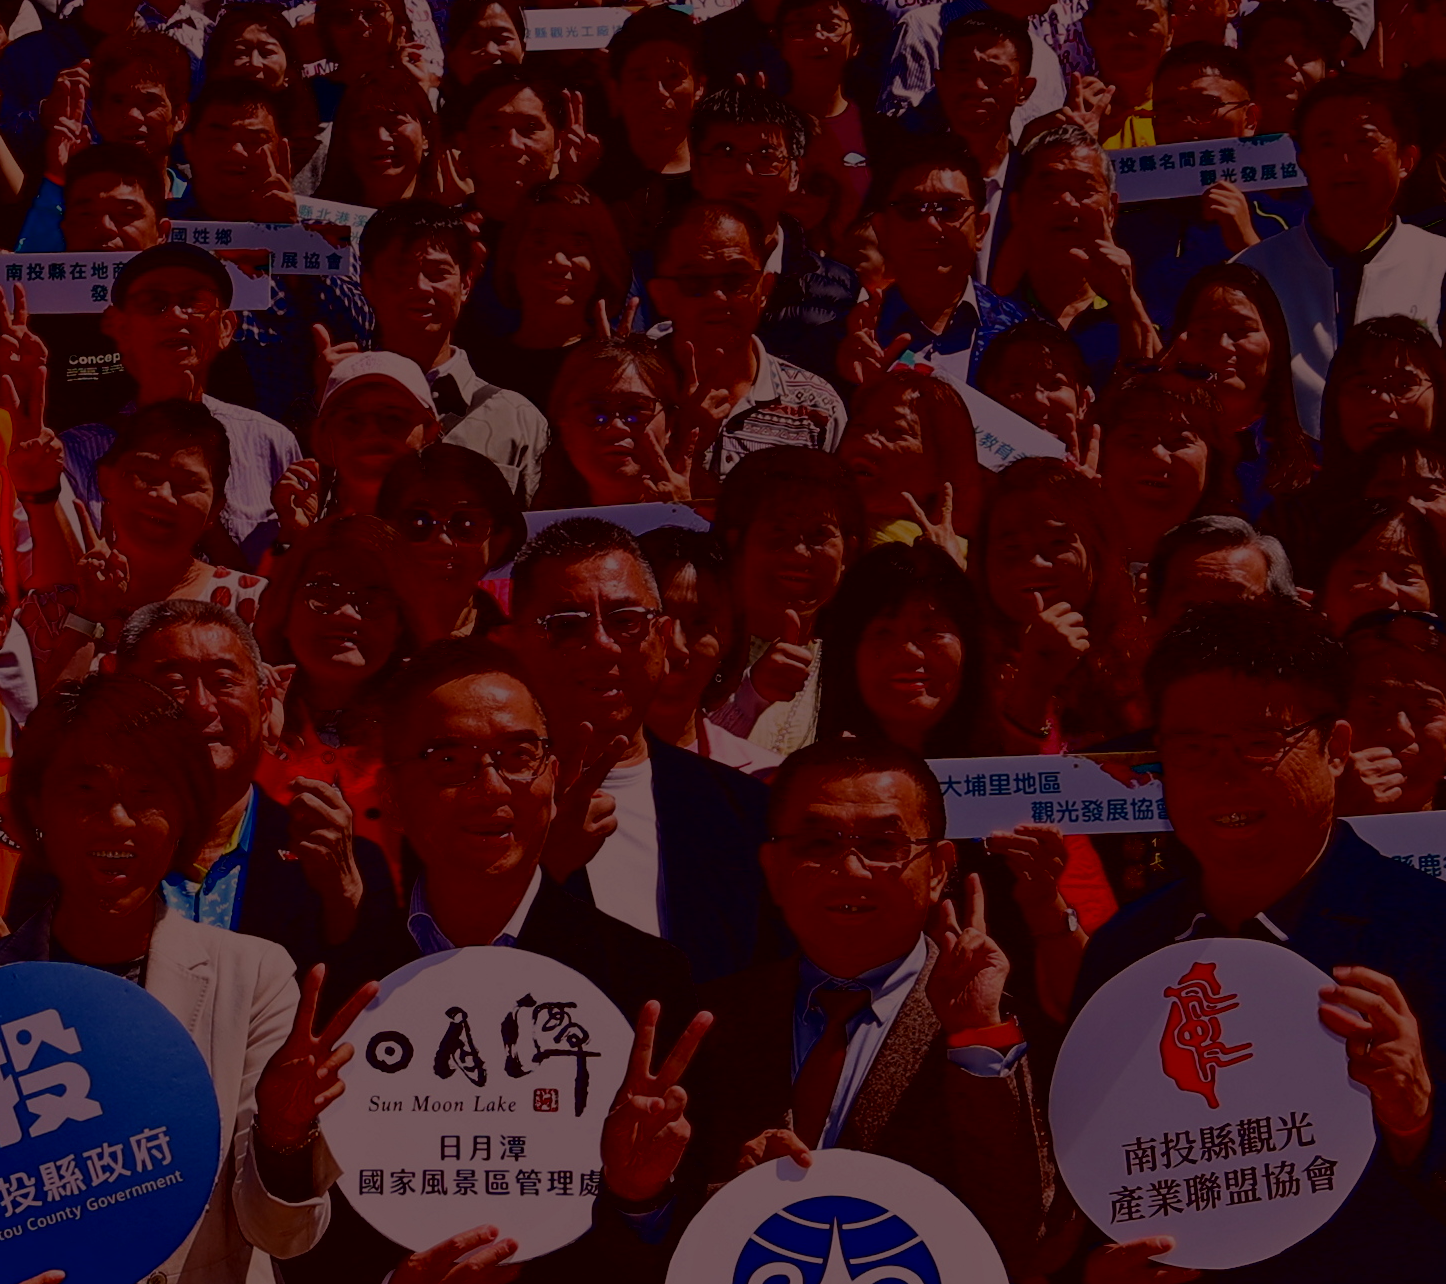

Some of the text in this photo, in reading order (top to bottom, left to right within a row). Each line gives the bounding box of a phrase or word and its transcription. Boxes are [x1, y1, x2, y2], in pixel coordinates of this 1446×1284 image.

[267, 250, 345, 271] 展協會
[90, 283, 109, 303] 發
[367, 1094, 404, 1113] Sun
[411, 1094, 465, 1113] Moon
[472, 1094, 518, 1113] Lake
[439, 1134, 529, 1163] 日月潭
[1121, 1111, 1317, 1177] 南投縣觀光
[359, 1168, 604, 1198] 國家風景區管理處
[1109, 1154, 1339, 1226] 產業聯盟協會
[25, 1202, 83, 1232] County
[85, 1169, 185, 1212] Government
